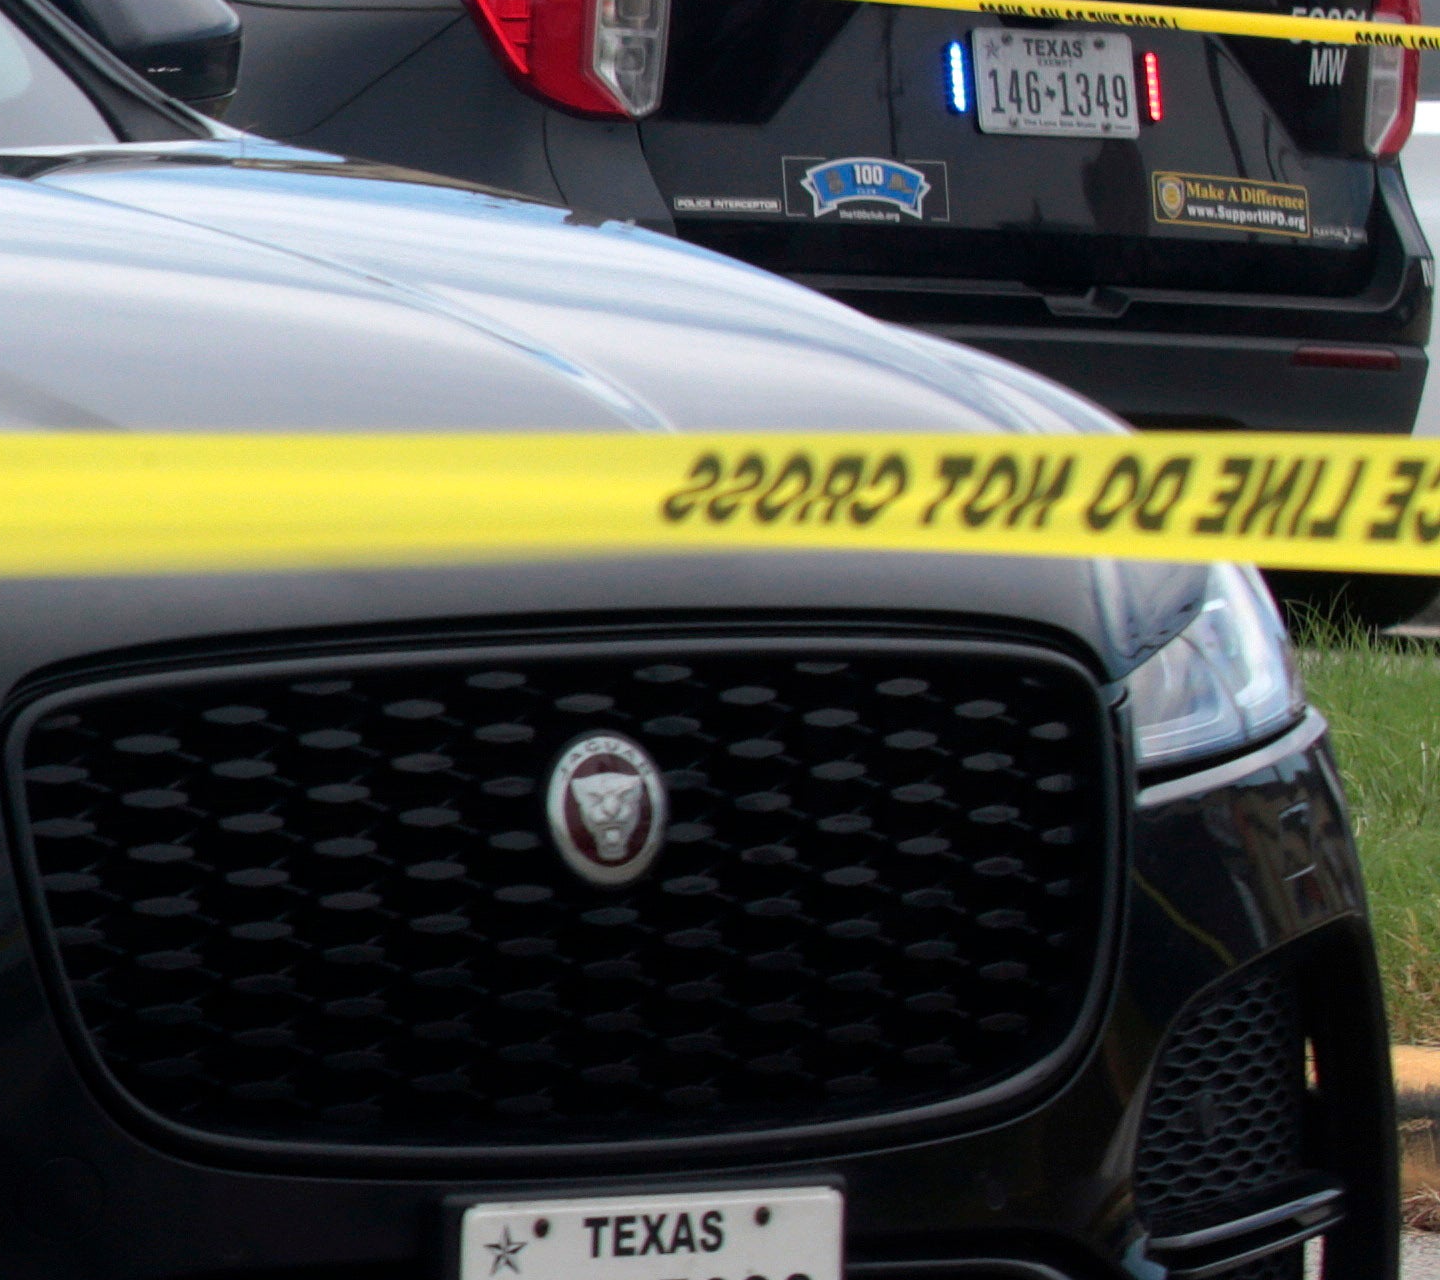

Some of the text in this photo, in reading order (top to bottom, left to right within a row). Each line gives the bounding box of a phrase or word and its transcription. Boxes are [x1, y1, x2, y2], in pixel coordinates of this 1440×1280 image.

[1023, 38, 1084, 59] TEXAS
[1309, 48, 1348, 86] MW
[854, 164, 884, 186] 100
[1186, 181, 1305, 210] Make A Difference
[1187, 204, 1306, 231] www.SupportHPD.org
[561, 740, 653, 774] JAGUAR
[584, 1210, 725, 1258] TEXAS
